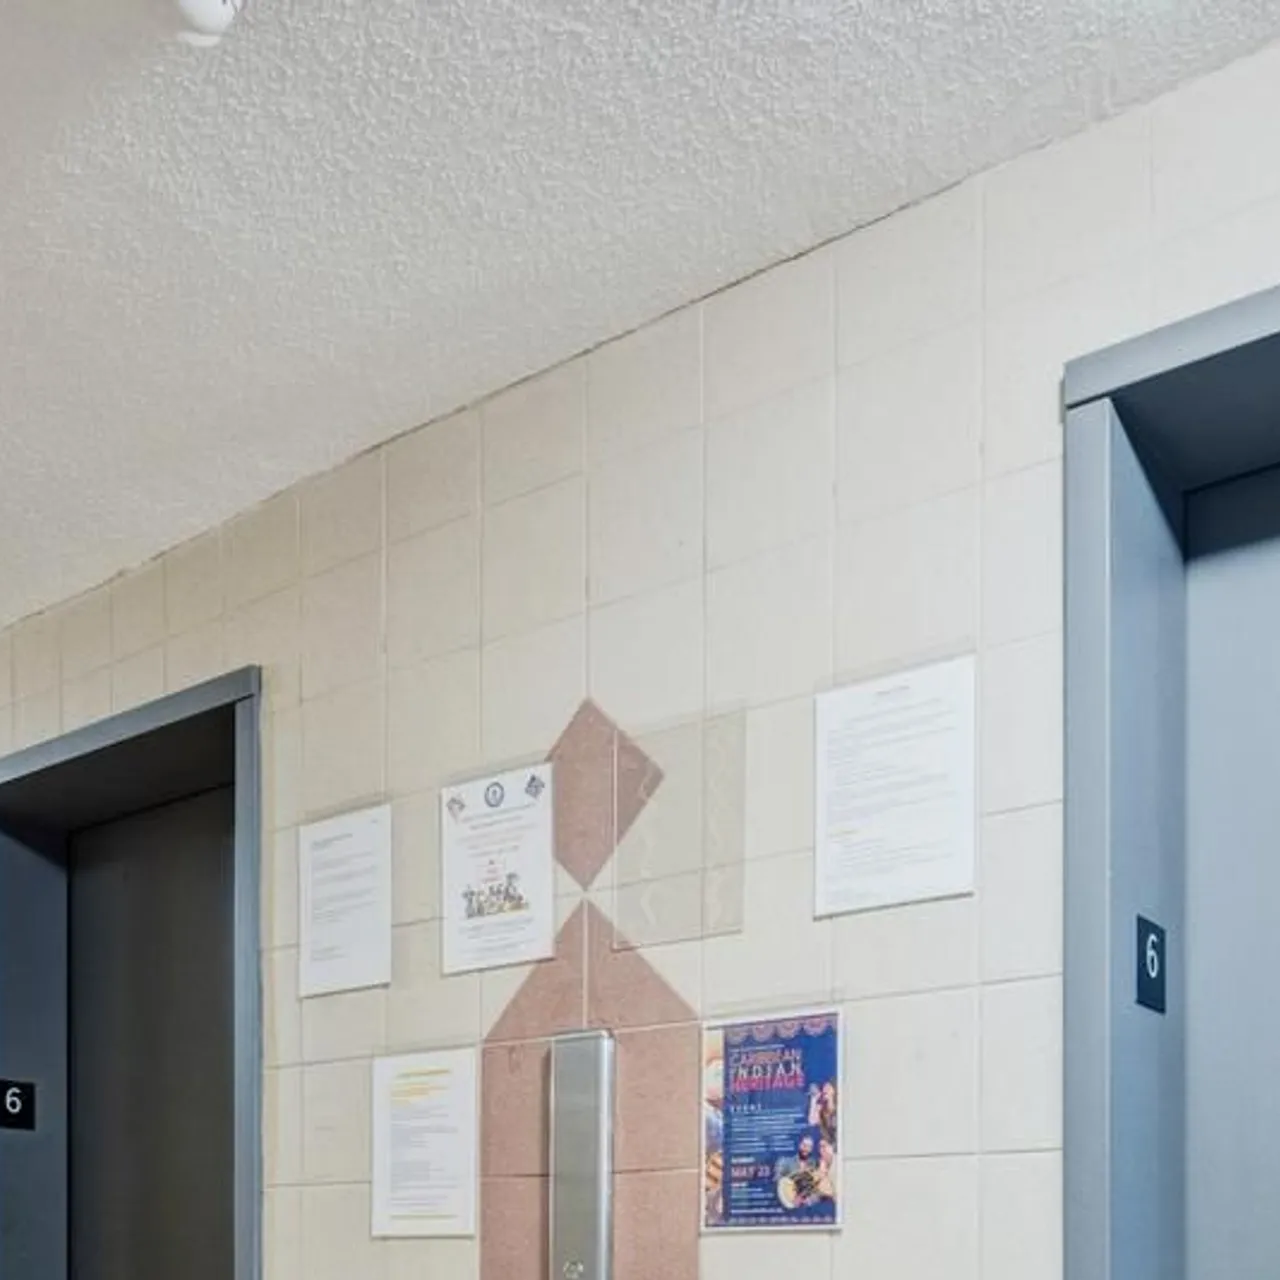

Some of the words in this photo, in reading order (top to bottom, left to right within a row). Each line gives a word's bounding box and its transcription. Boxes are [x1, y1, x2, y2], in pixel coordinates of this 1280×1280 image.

[1146, 933, 1159, 979] 6
[729, 1058, 804, 1080] INDIAN
[6, 1087, 22, 1114] 6
